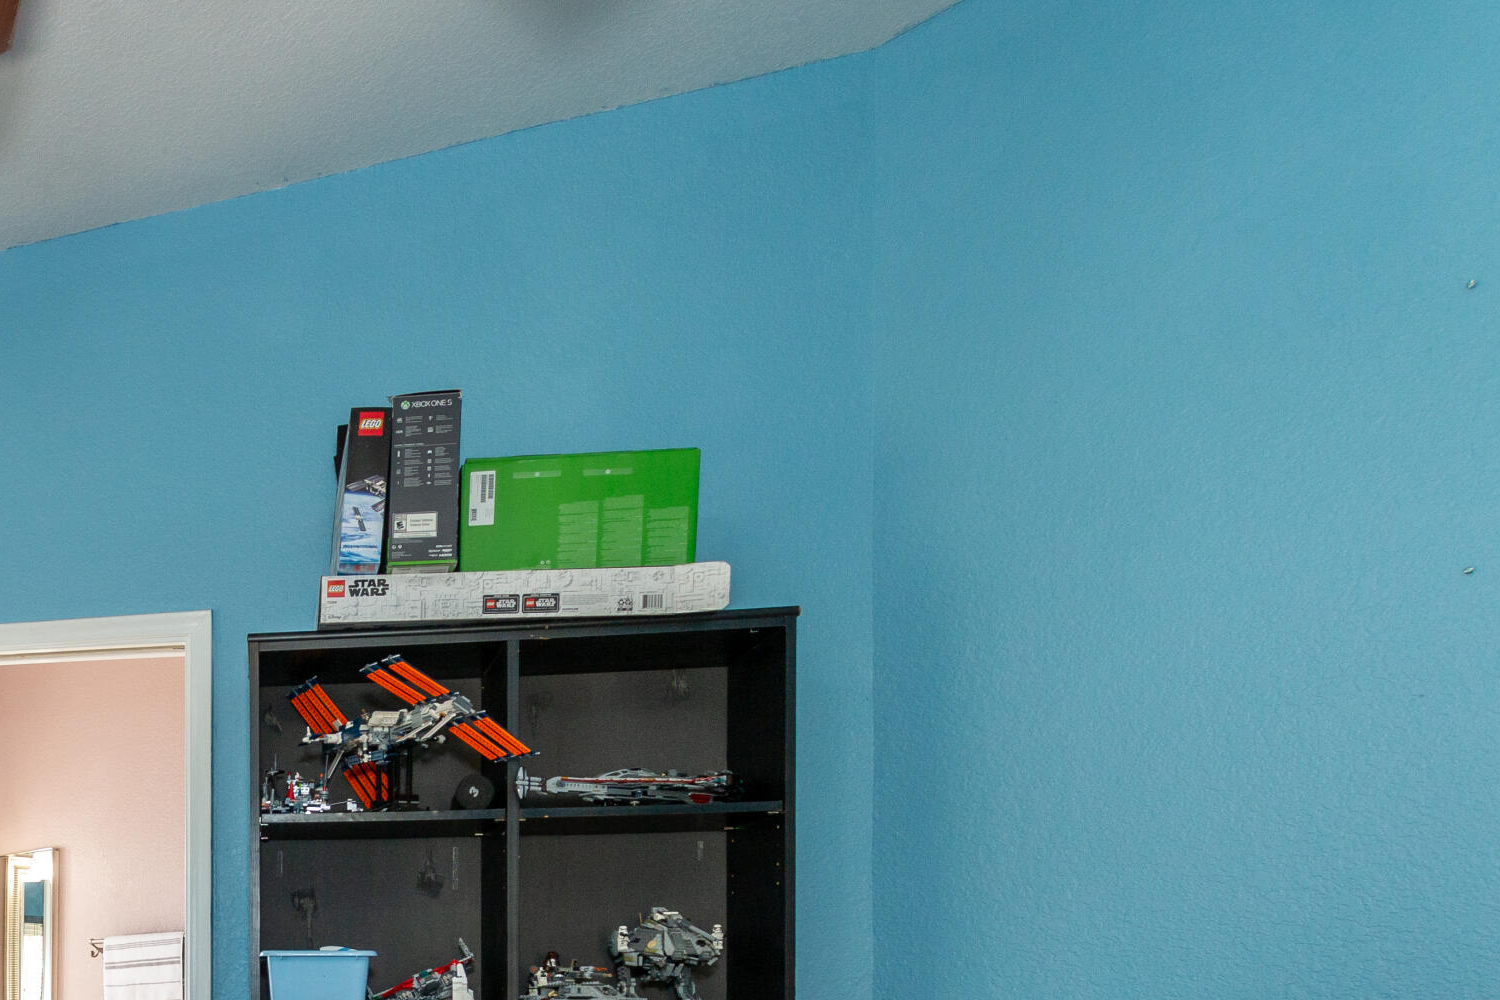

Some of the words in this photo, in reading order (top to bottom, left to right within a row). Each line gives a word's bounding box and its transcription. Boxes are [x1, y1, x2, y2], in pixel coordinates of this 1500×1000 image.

[411, 400, 430, 409] XBOX
[360, 419, 382, 429] LEGO
[349, 579, 390, 588] STAR
[328, 585, 344, 593] LEGO
[349, 588, 390, 597] WARS
